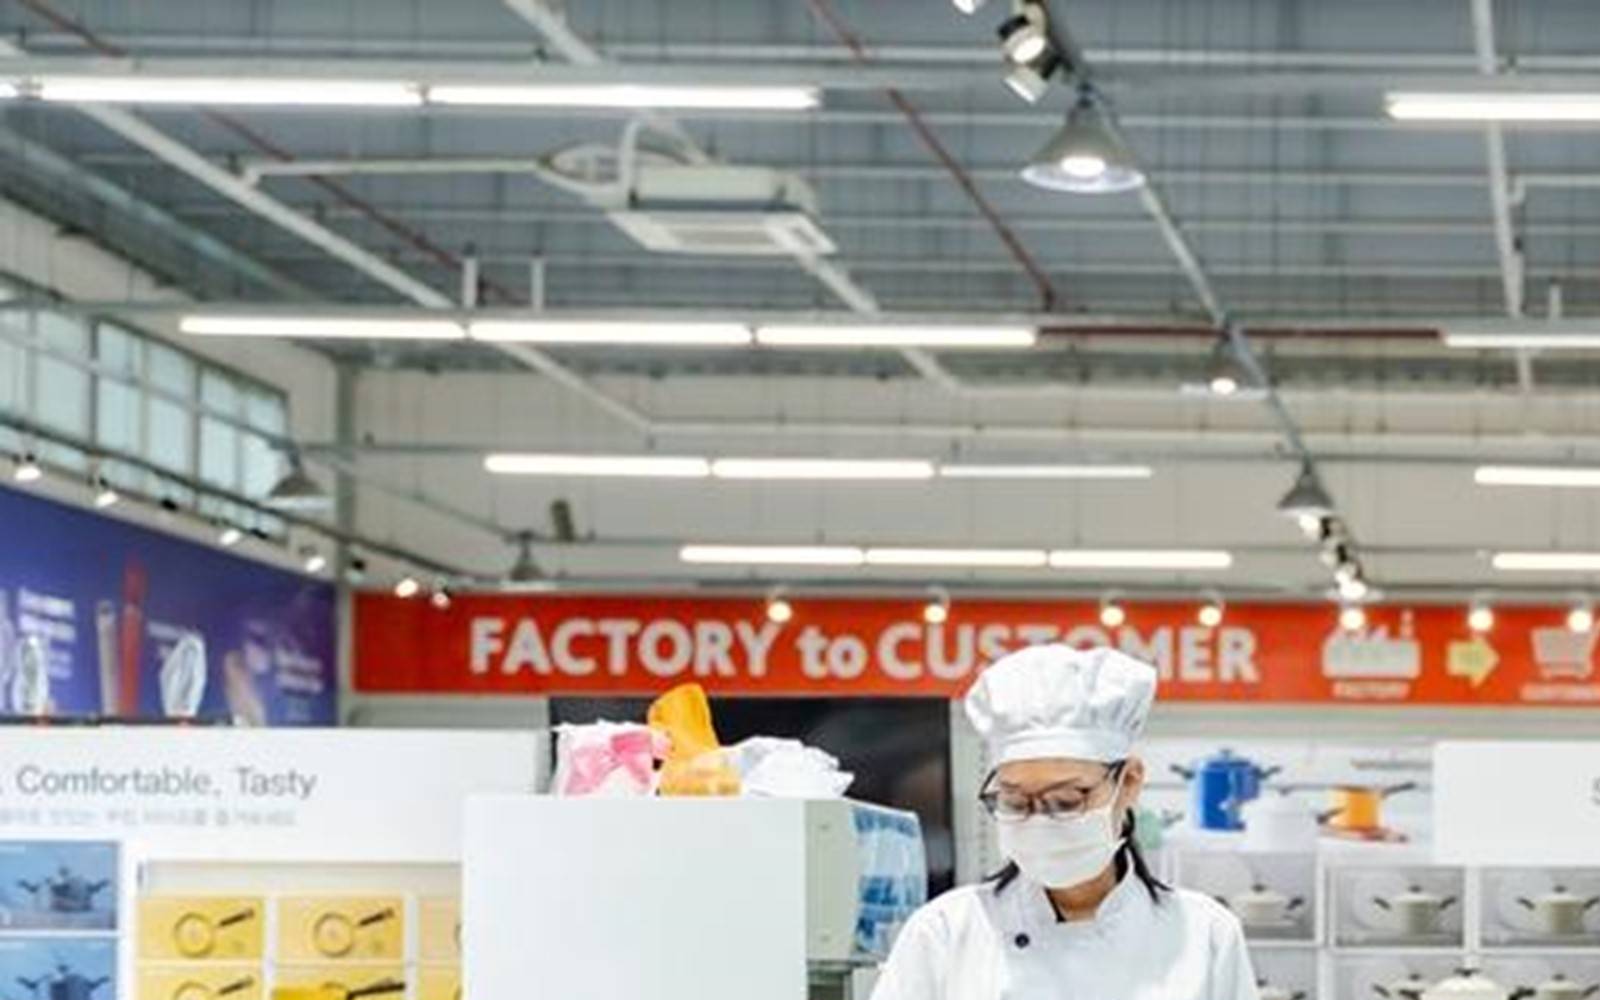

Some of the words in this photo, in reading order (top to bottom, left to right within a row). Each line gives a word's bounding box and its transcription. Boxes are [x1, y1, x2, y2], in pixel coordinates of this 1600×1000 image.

[469, 616, 785, 678] FACTORY
[796, 625, 868, 679] to
[236, 765, 317, 800] Tasty
